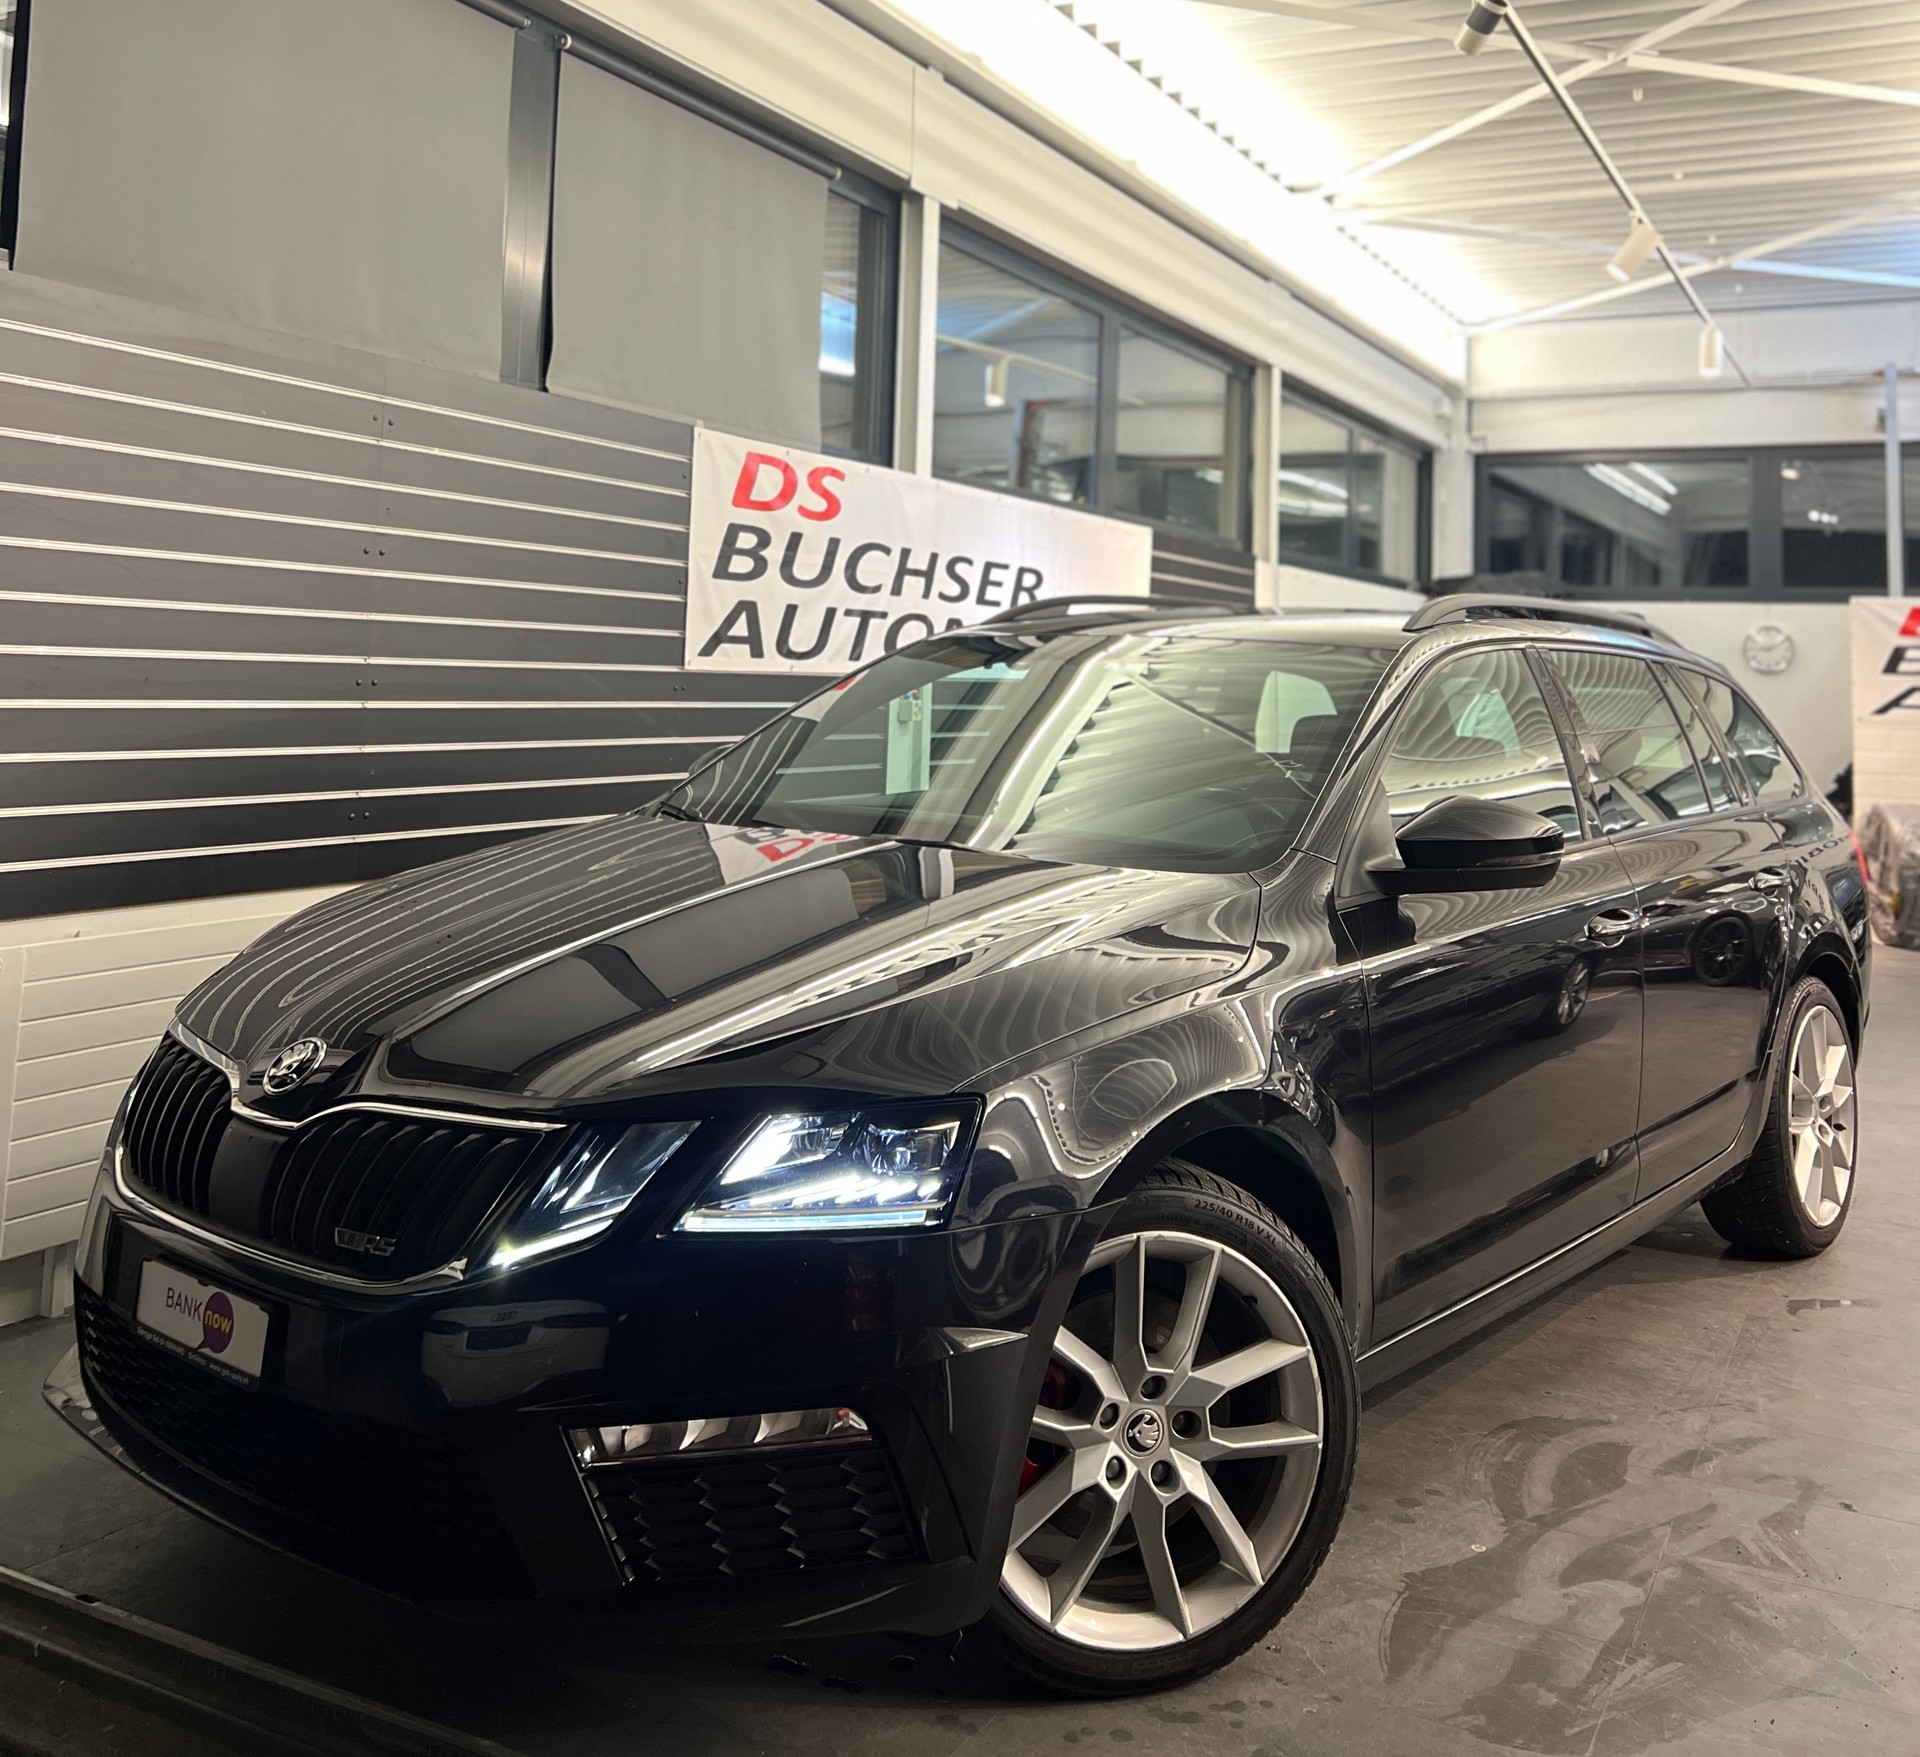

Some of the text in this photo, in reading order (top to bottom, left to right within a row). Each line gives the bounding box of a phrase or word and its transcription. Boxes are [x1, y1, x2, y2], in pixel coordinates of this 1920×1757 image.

[731, 451, 846, 521] DS
[712, 523, 1043, 607] BUCHSER
[698, 600, 964, 661] AUTO
[1194, 1200, 1233, 1218] 225/40
[1235, 1213, 1254, 1229] R18
[166, 1287, 232, 1334] BANK now
